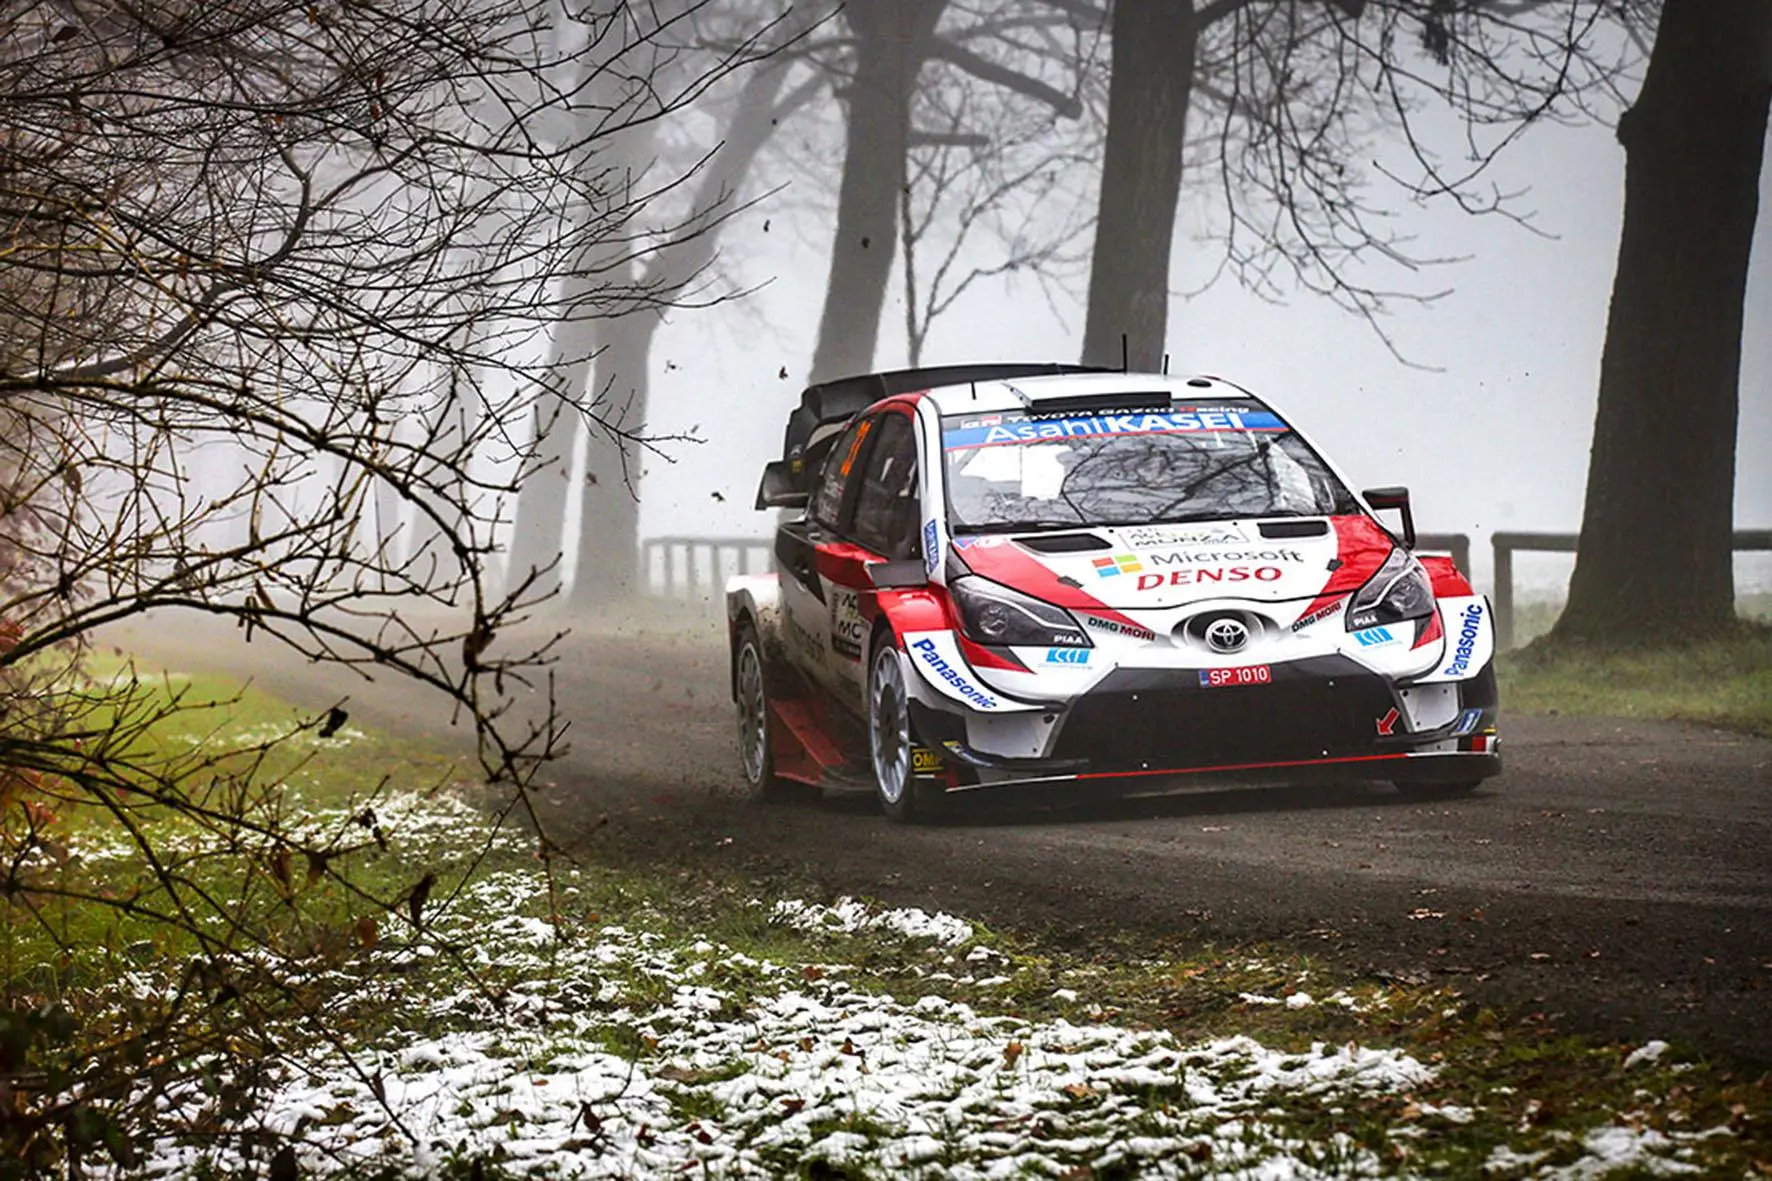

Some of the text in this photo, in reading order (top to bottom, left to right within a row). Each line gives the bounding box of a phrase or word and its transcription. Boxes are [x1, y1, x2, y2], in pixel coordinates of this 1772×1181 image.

[1150, 549, 1305, 567] Microsoft
[1136, 566, 1283, 591] DENSO
[1087, 616, 1157, 642] DMG MORI
[1291, 601, 1343, 633] DMG MORI
[1443, 603, 1484, 677] Panasonic
[911, 637, 998, 709] Panasonic
[1209, 667, 1269, 685] SP 1010
